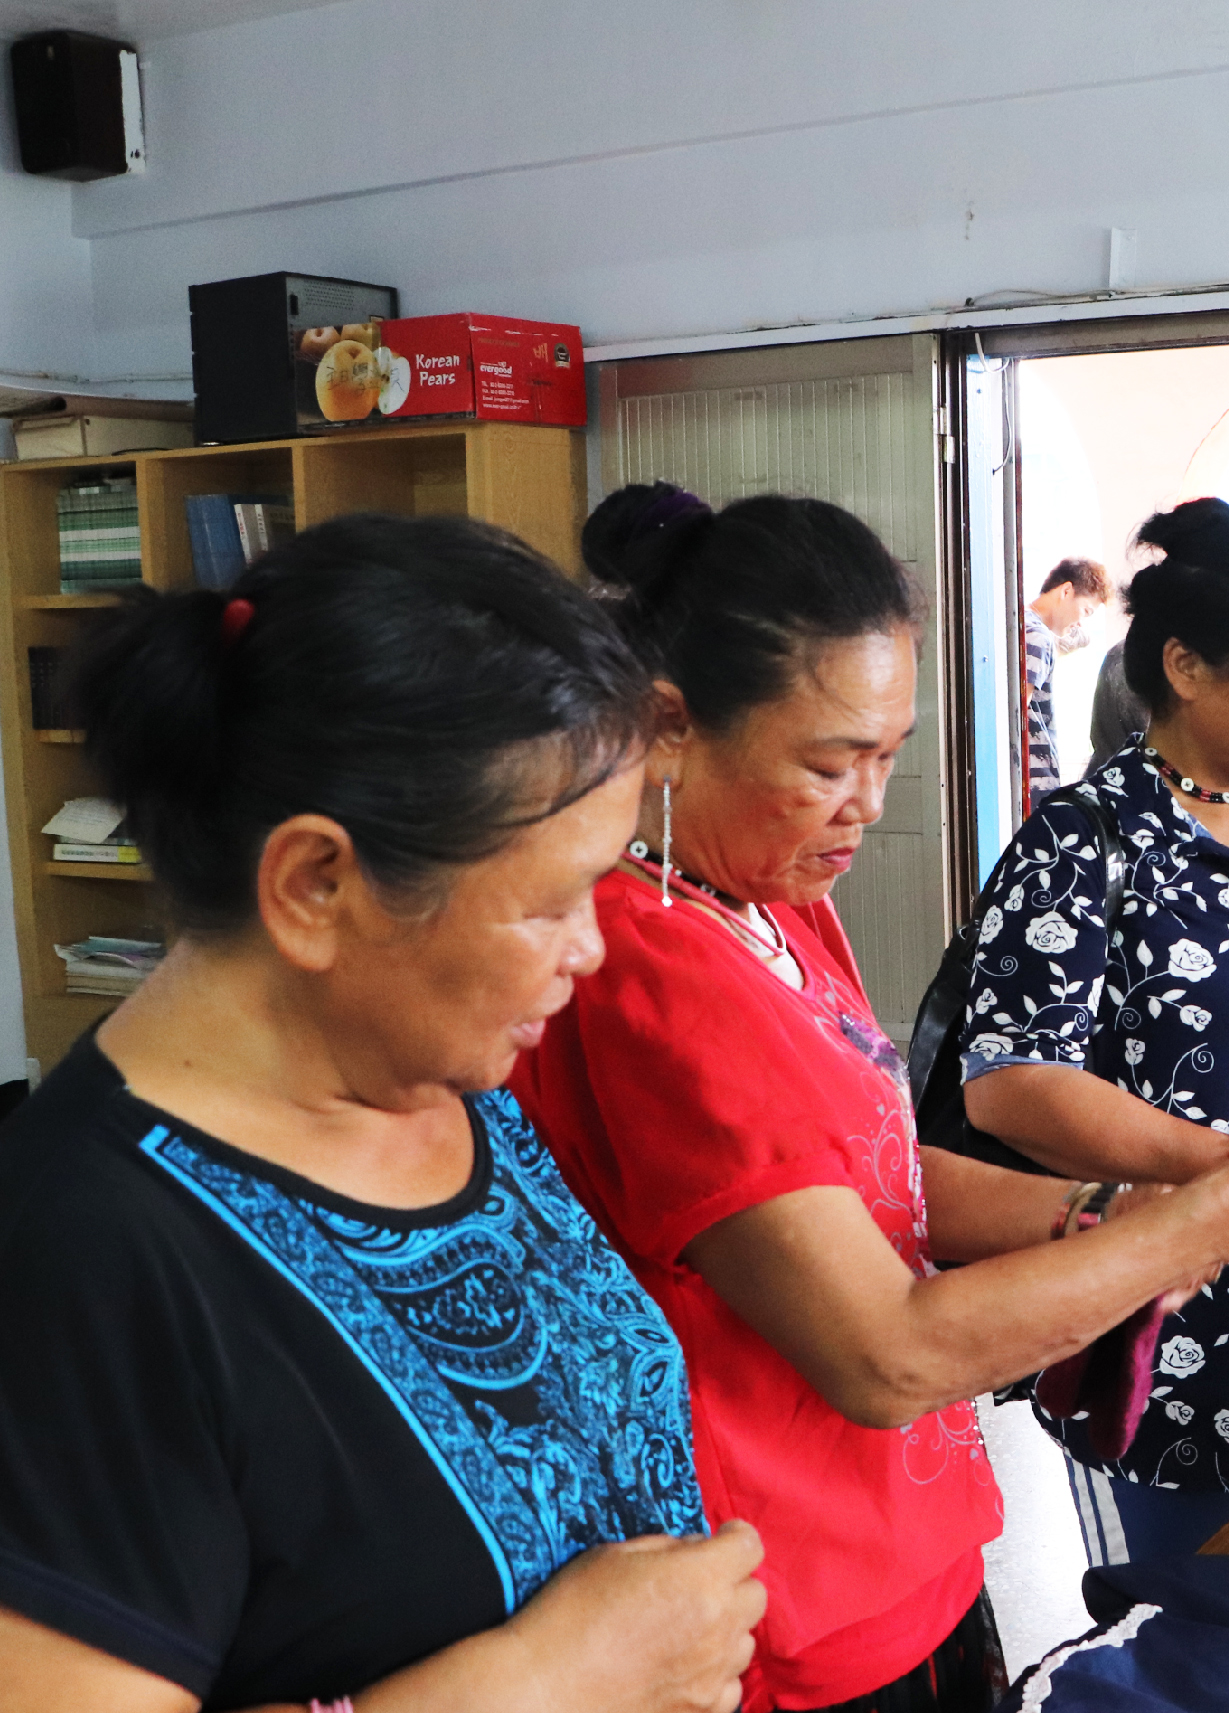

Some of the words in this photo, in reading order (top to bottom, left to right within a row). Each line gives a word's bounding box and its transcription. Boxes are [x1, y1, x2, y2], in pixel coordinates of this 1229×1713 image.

[415, 353, 460, 370] Korean
[480, 364, 512, 376] evergood
[419, 370, 456, 387] Pears
